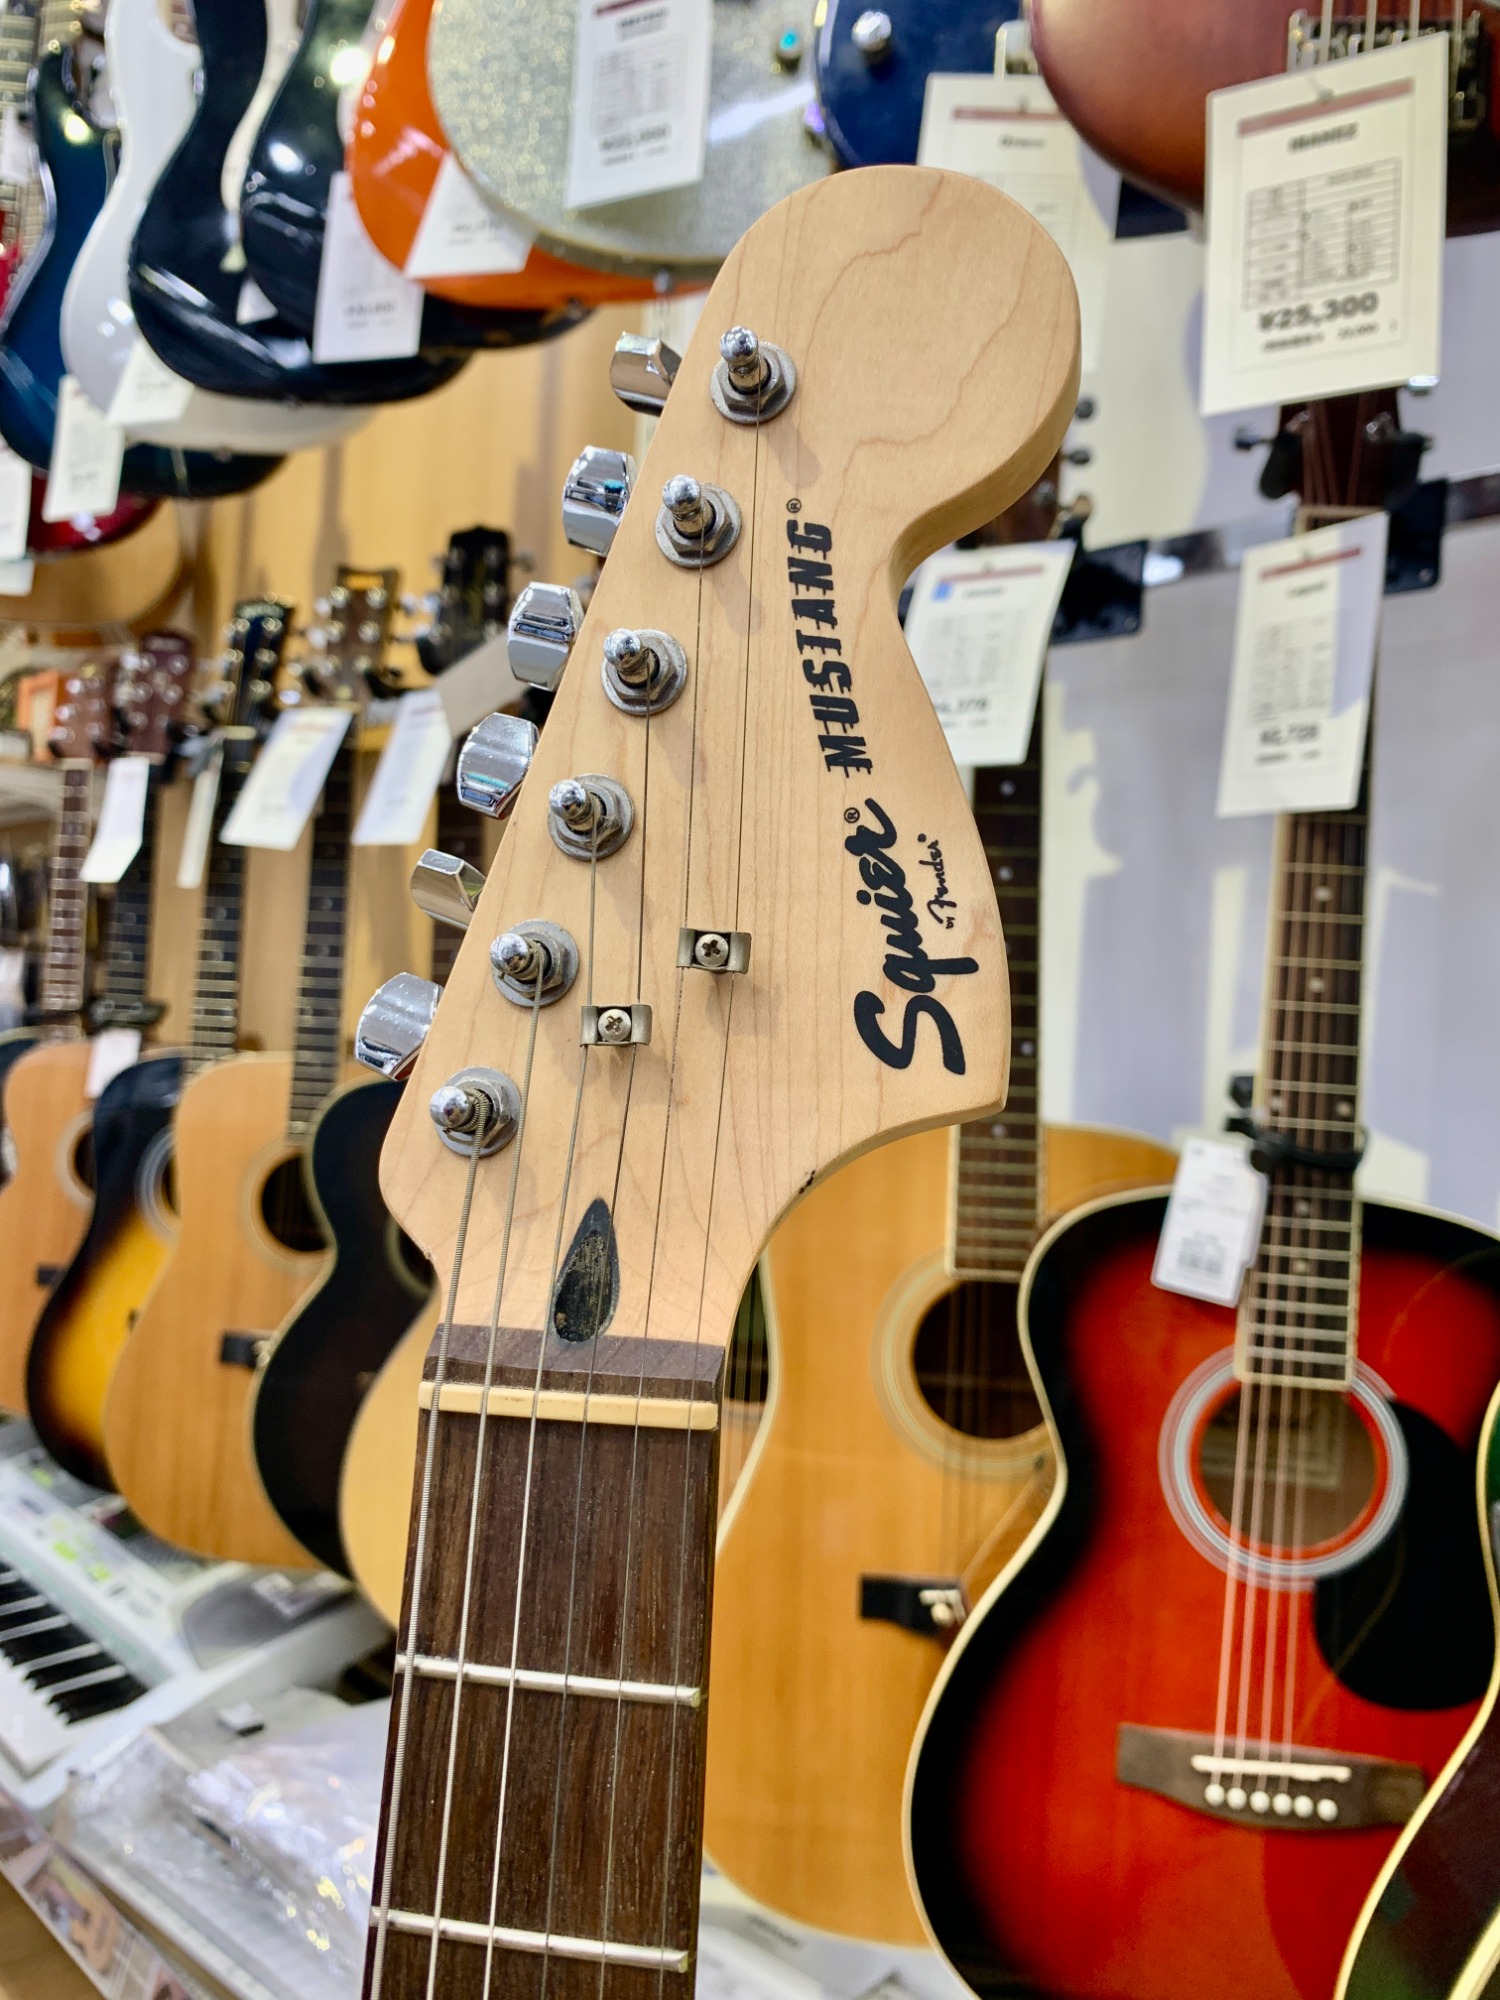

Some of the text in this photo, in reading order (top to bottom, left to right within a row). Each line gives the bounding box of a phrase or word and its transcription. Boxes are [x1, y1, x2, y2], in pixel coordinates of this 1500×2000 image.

[1258, 290, 1379, 332] ¥25,300
[787, 519, 873, 779] MUSTANG
[844, 797, 979, 1076] Squier
[917, 833, 958, 930] by Fender
